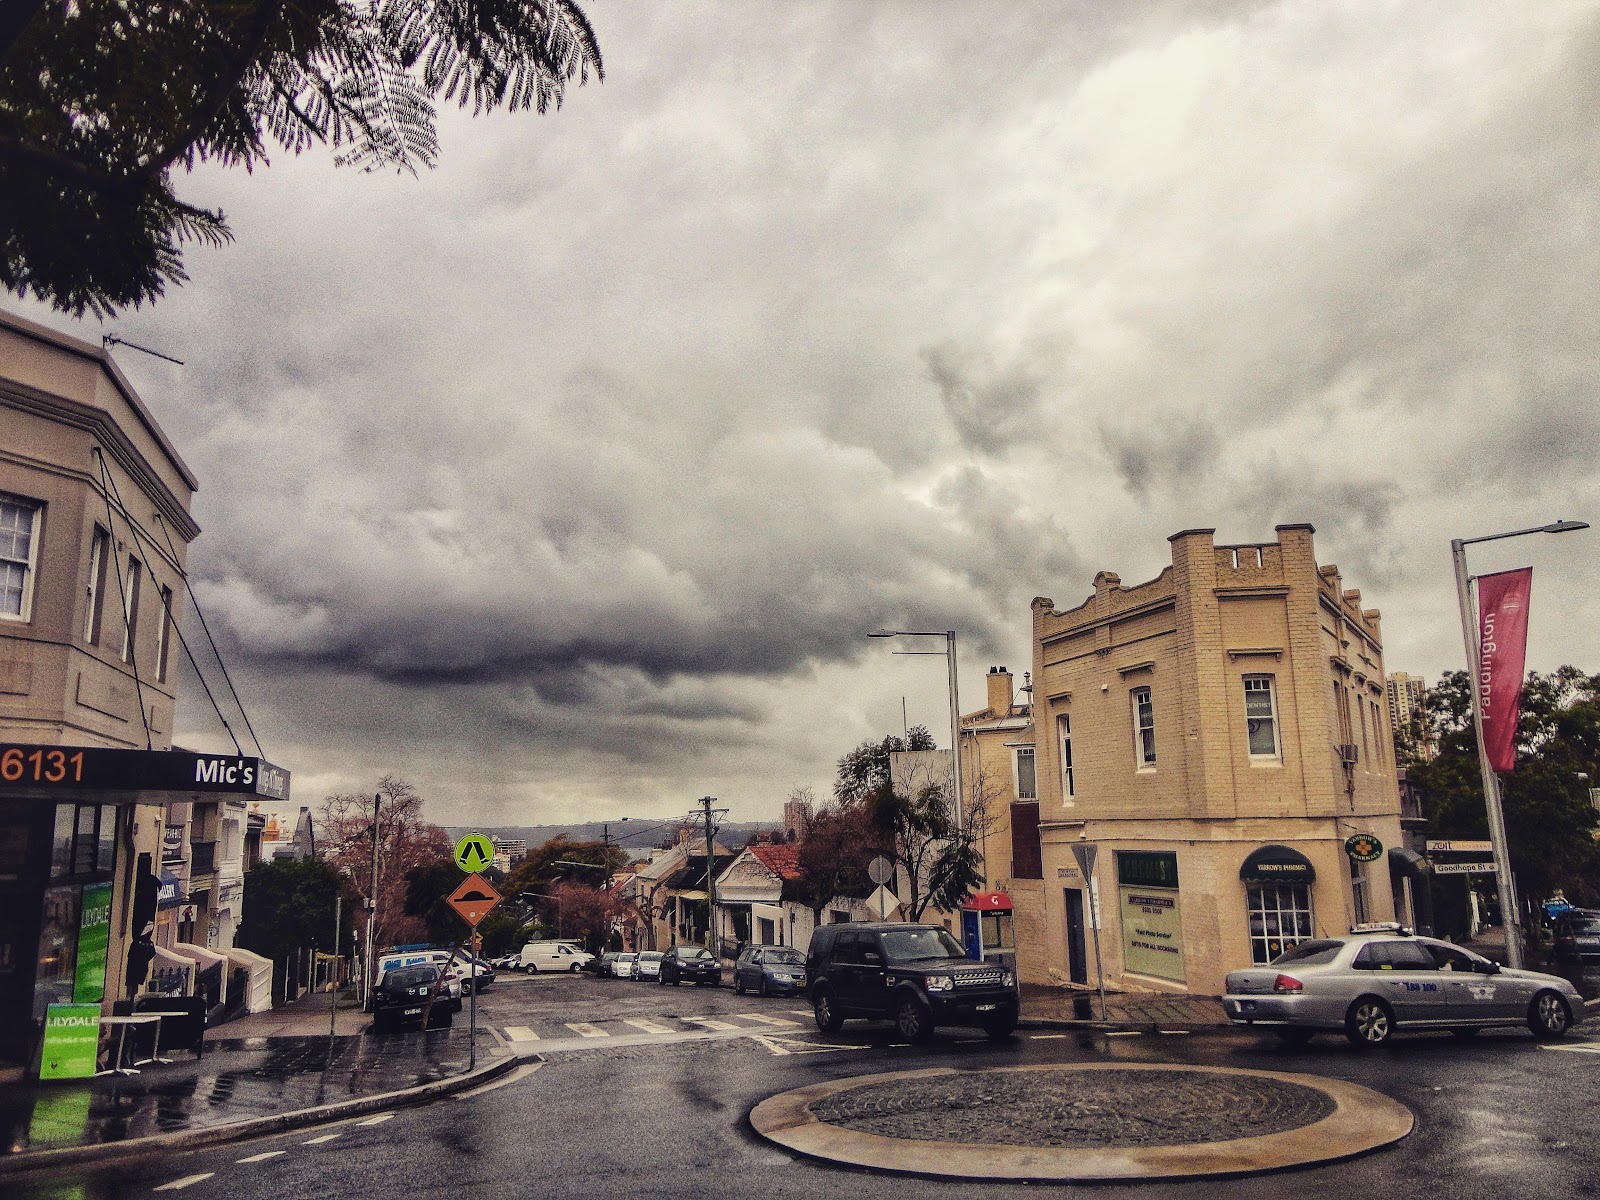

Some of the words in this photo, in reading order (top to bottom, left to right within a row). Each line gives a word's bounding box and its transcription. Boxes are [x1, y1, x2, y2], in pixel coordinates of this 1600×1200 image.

[1480, 612, 1497, 720] Paddington
[1, 748, 84, 782] 6131
[195, 758, 253, 785] Mic's
[1438, 864, 1476, 872] Goodhope
[1477, 863, 1486, 871] St
[47, 1016, 99, 1027] LILYDALE
